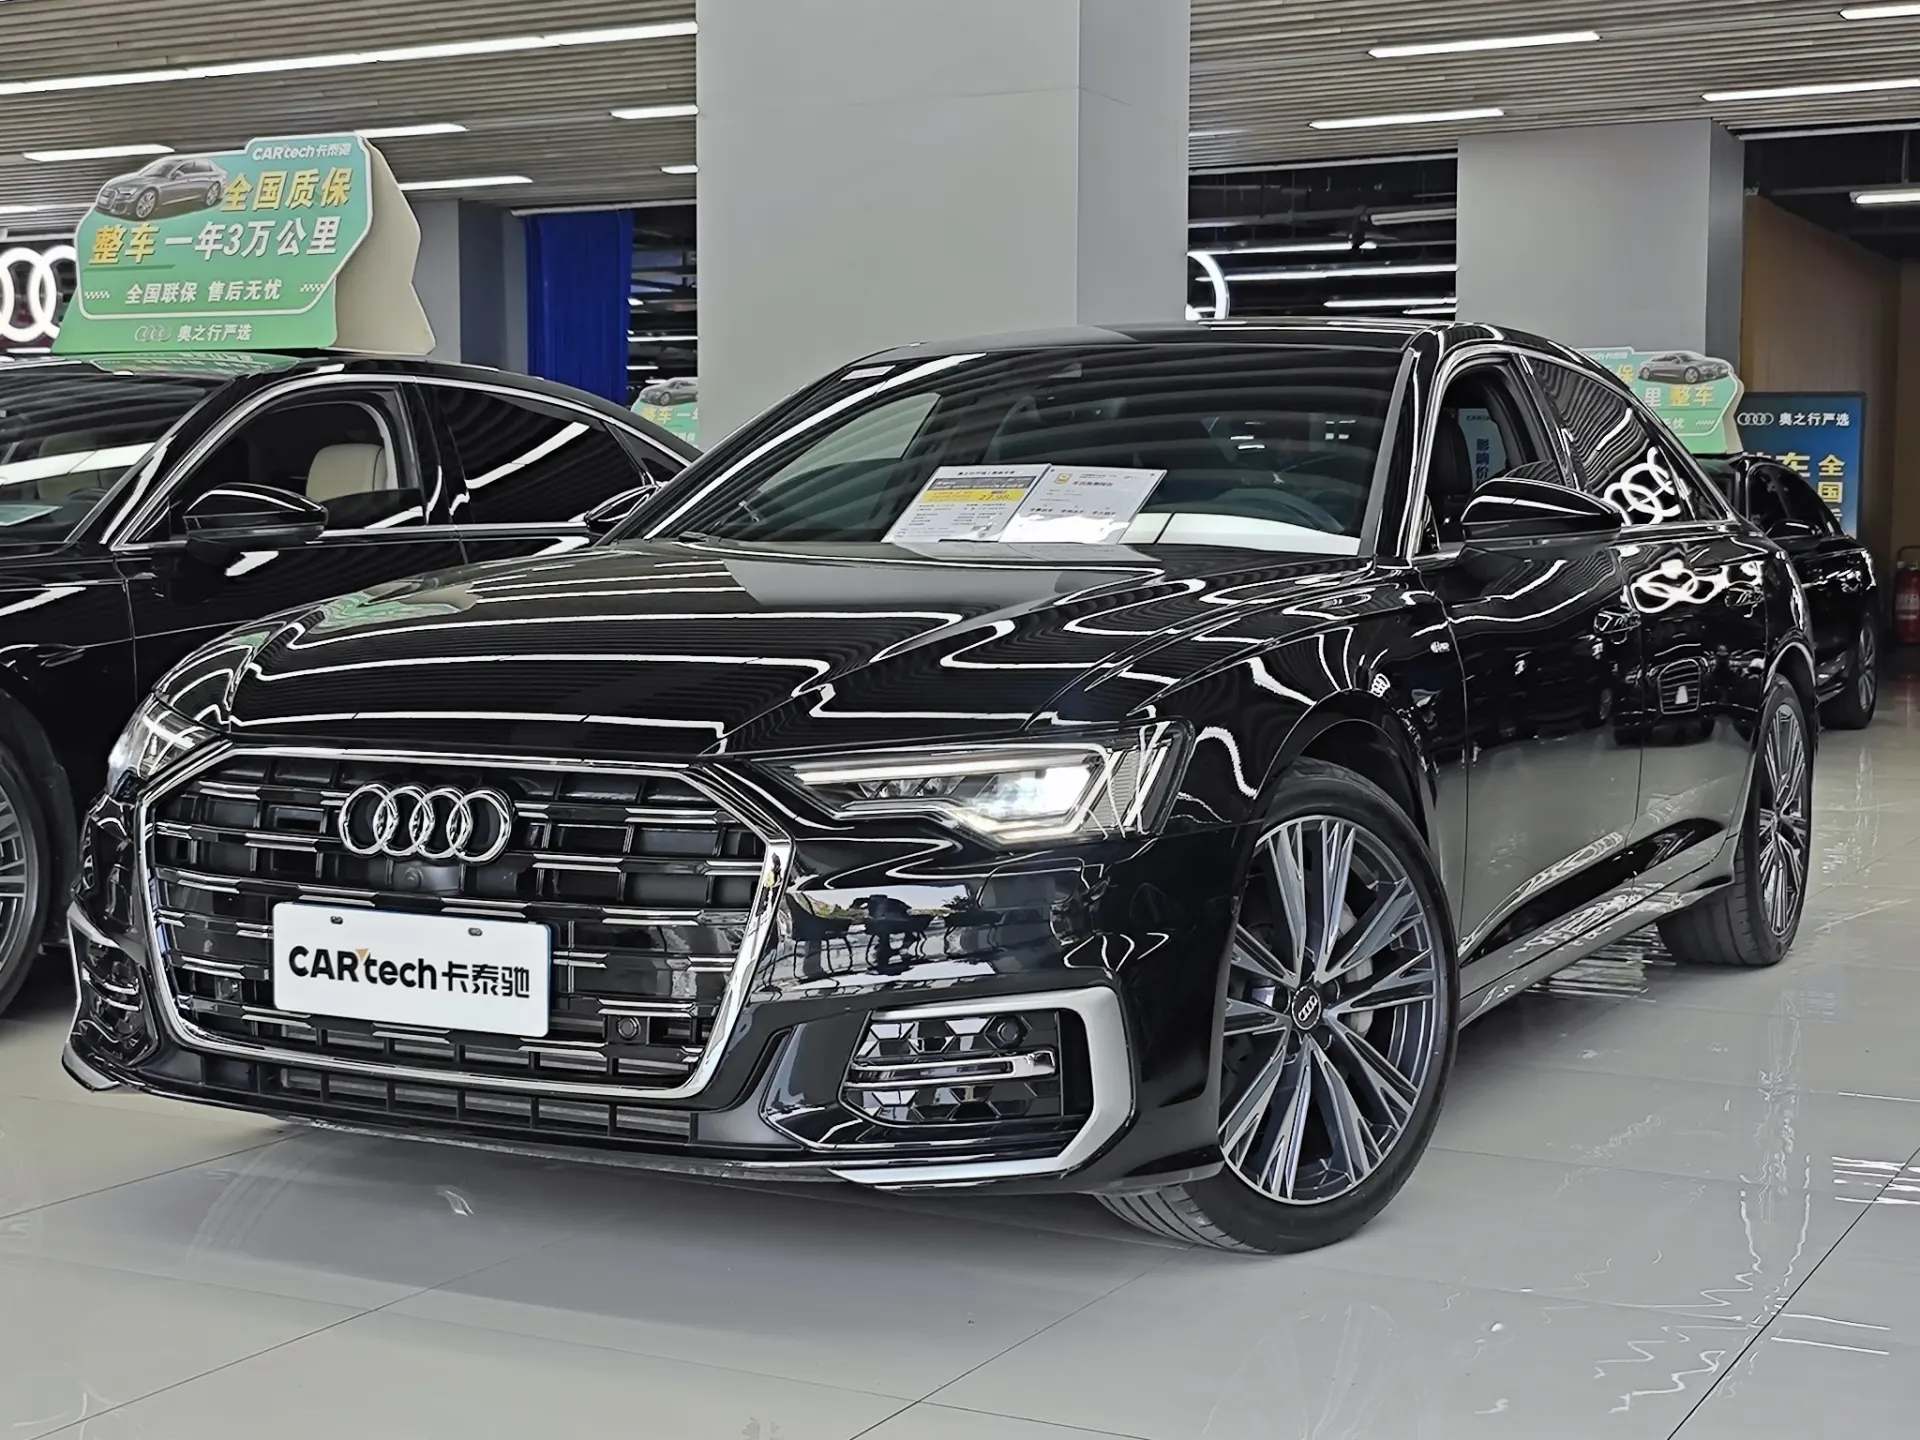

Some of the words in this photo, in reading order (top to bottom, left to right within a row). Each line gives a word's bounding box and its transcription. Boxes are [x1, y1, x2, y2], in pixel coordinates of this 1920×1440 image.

[221, 166, 353, 213] 全国质保
[125, 282, 198, 305] 全国联保
[207, 279, 282, 303] 售后无忧
[177, 323, 252, 342] 奥之行严选
[1779, 412, 1849, 427] 奥之行严选
